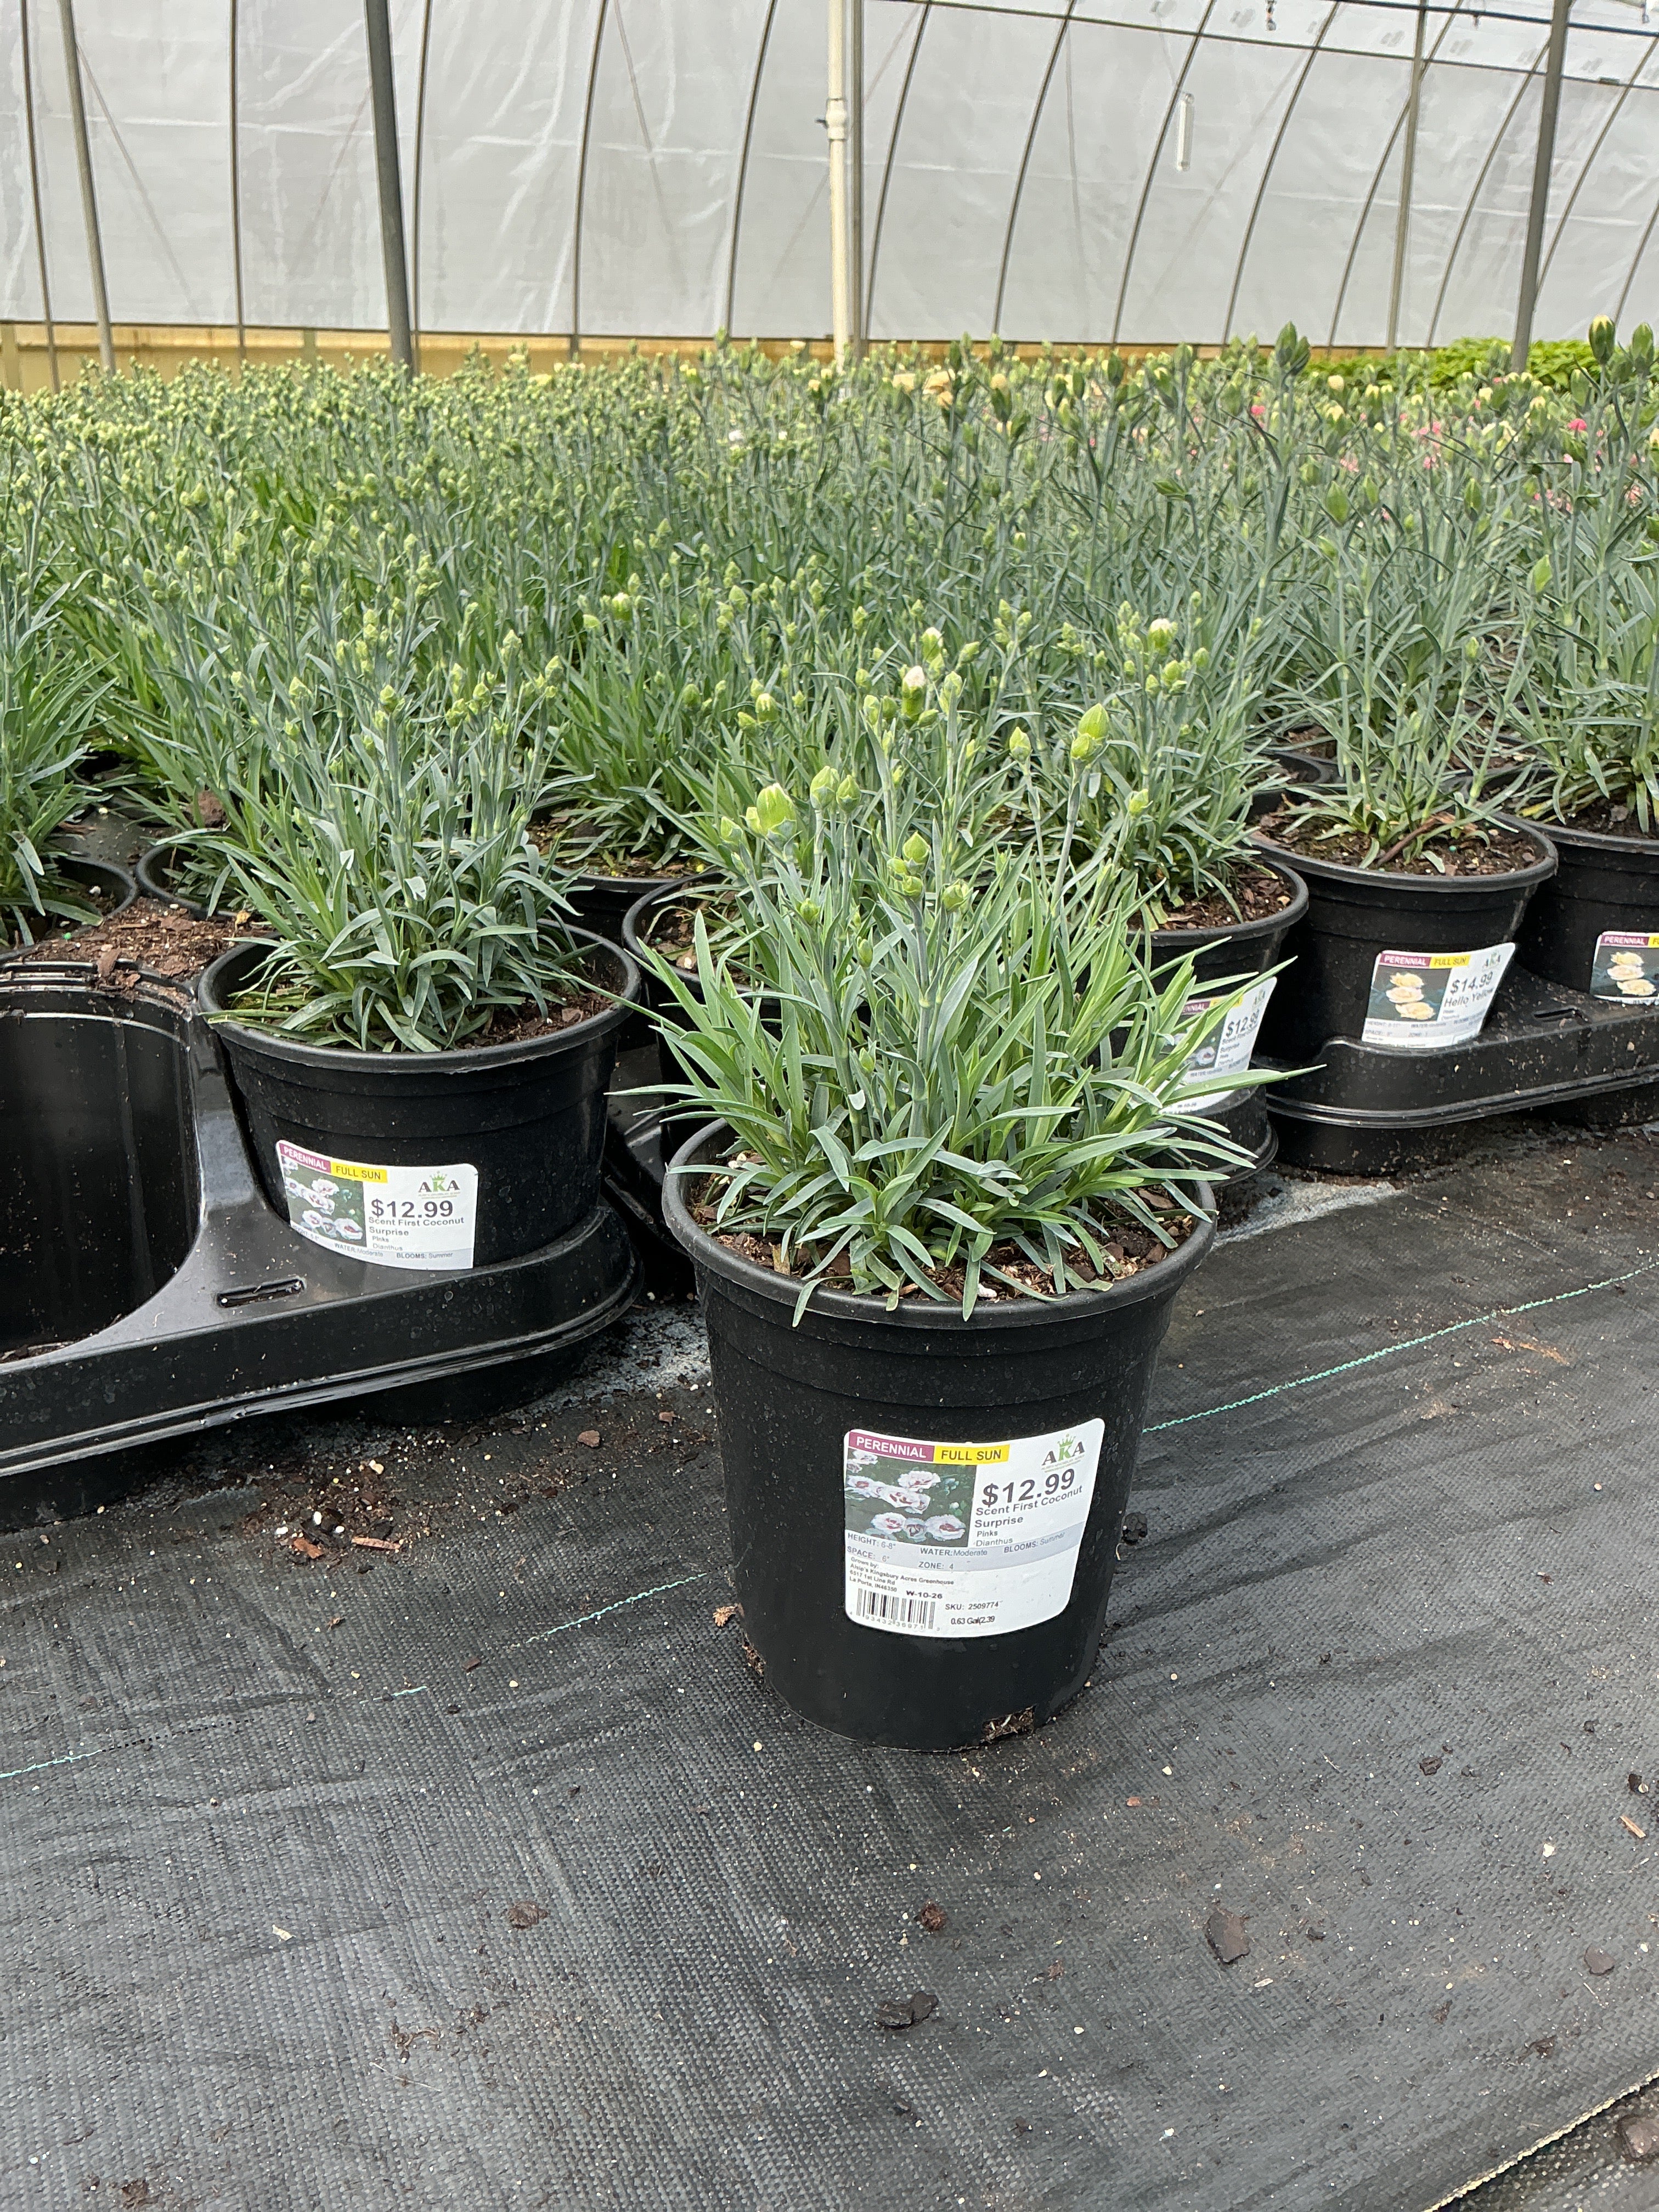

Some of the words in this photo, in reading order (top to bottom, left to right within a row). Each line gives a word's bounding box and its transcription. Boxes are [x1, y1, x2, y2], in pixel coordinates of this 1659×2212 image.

[1604, 935, 1645, 946] PERENNIAL
[1384, 956, 1427, 966] PERENNIAL
[1453, 957, 1467, 965] SUN
[1450, 972, 1493, 995] $14.99
[1444, 996, 1469, 1007] Hello
[284, 1147, 327, 1170] PERENNIAL
[336, 1165, 359, 1177] FULL
[361, 1170, 381, 1180] SUN
[418, 1180, 460, 1193] AKA
[371, 1199, 453, 1218] $12.99
[368, 1216, 396, 1226] Scent
[423, 1217, 465, 1226] Coconut
[369, 1226, 409, 1236] Surprise
[856, 1436, 927, 1459] PERENNIAL
[941, 1450, 973, 1461] FULL
[977, 1449, 1002, 1460] SUN
[1041, 1441, 1086, 1466] AKA
[981, 1468, 1075, 1508] $12.99
[975, 1506, 1010, 1516] Scent
[1013, 1500, 1039, 1512] First
[1041, 1485, 1083, 1506] Coconut
[974, 1516, 1024, 1528] Surprise
[848, 1533, 879, 1547] HEIGHT:
[975, 1537, 1013, 1547] Dianthus
[1003, 1542, 1039, 1554] BLOOMS:
[1040, 1532, 1065, 1546] Summer
[847, 1545, 876, 1560] SPACE:
[953, 1548, 988, 1556] Moderate
[850, 1556, 869, 1566] Grown
[918, 1561, 944, 1570] ZONE:
[870, 1569, 899, 1580] Kingsbury
[906, 1590, 943, 1599] W-10-26
[967, 1601, 999, 1610] 2509774
